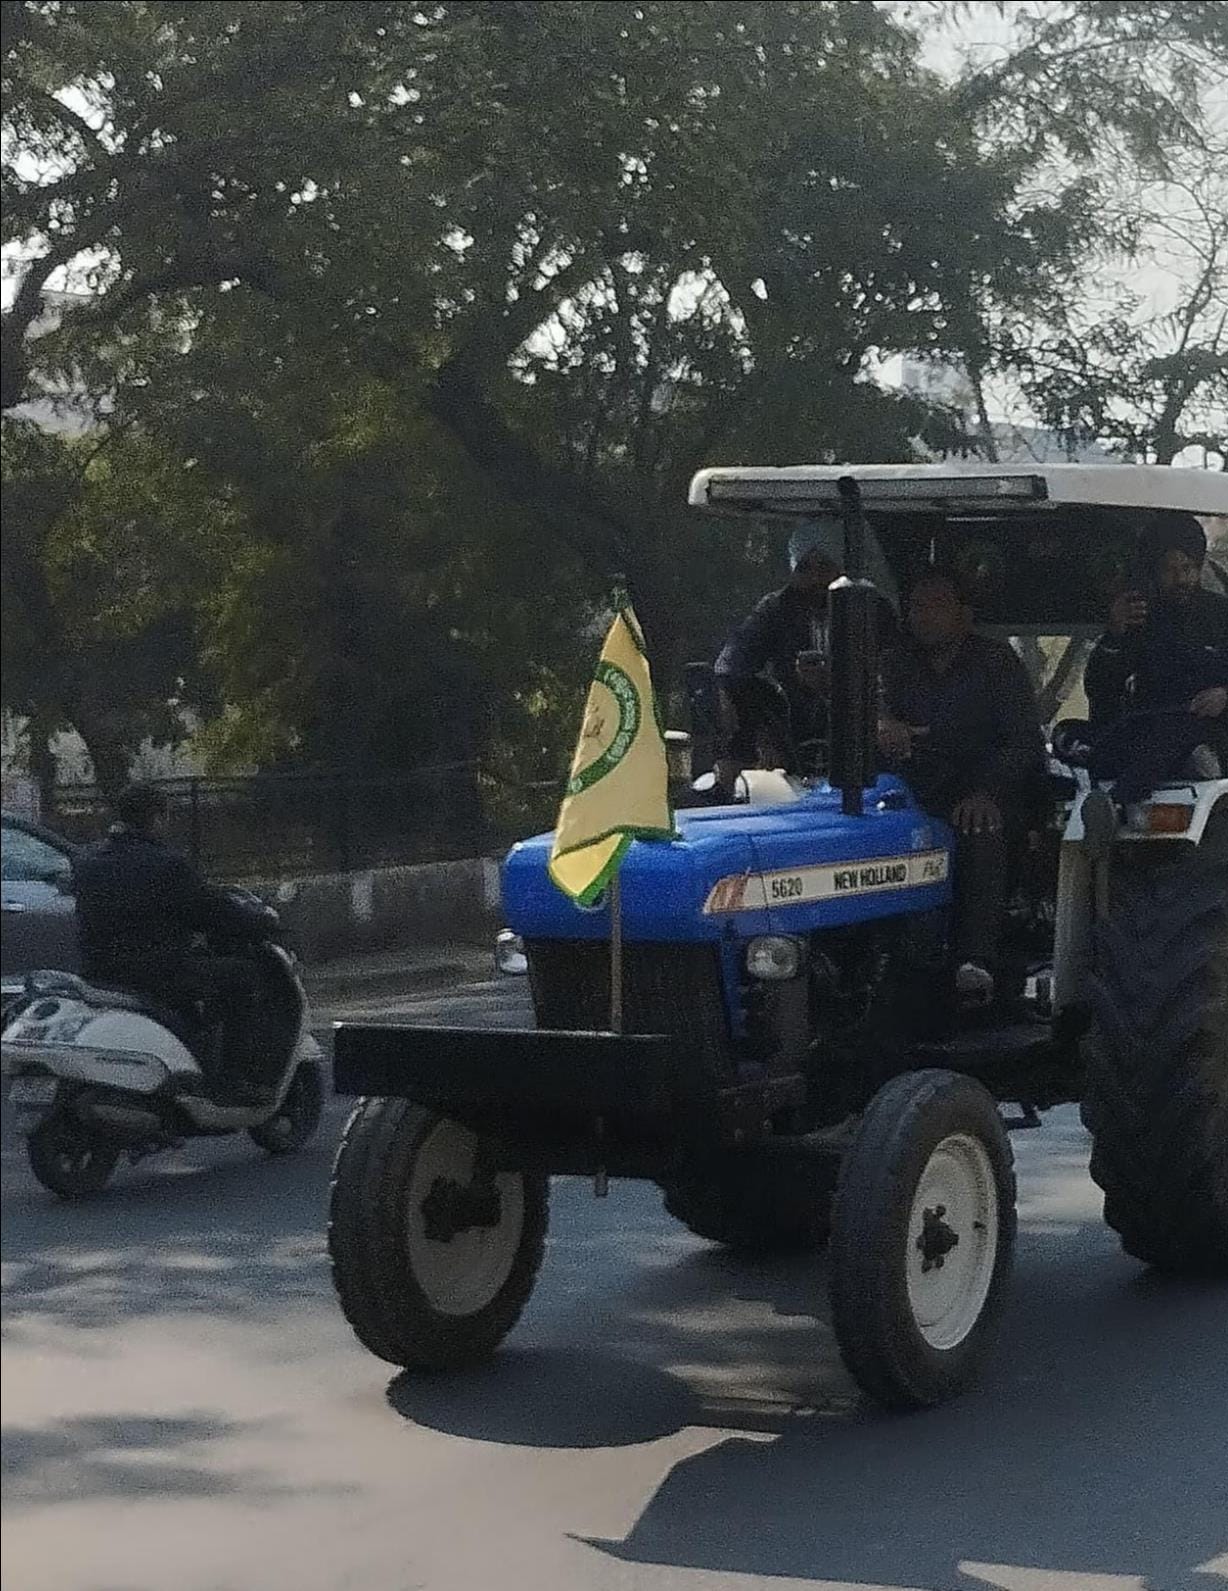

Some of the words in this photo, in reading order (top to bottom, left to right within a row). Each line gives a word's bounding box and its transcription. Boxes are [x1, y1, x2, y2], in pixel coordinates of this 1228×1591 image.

[771, 877, 803, 899] 5620
[833, 869, 859, 891] NEW
[860, 862, 907, 887] HOLLAND
